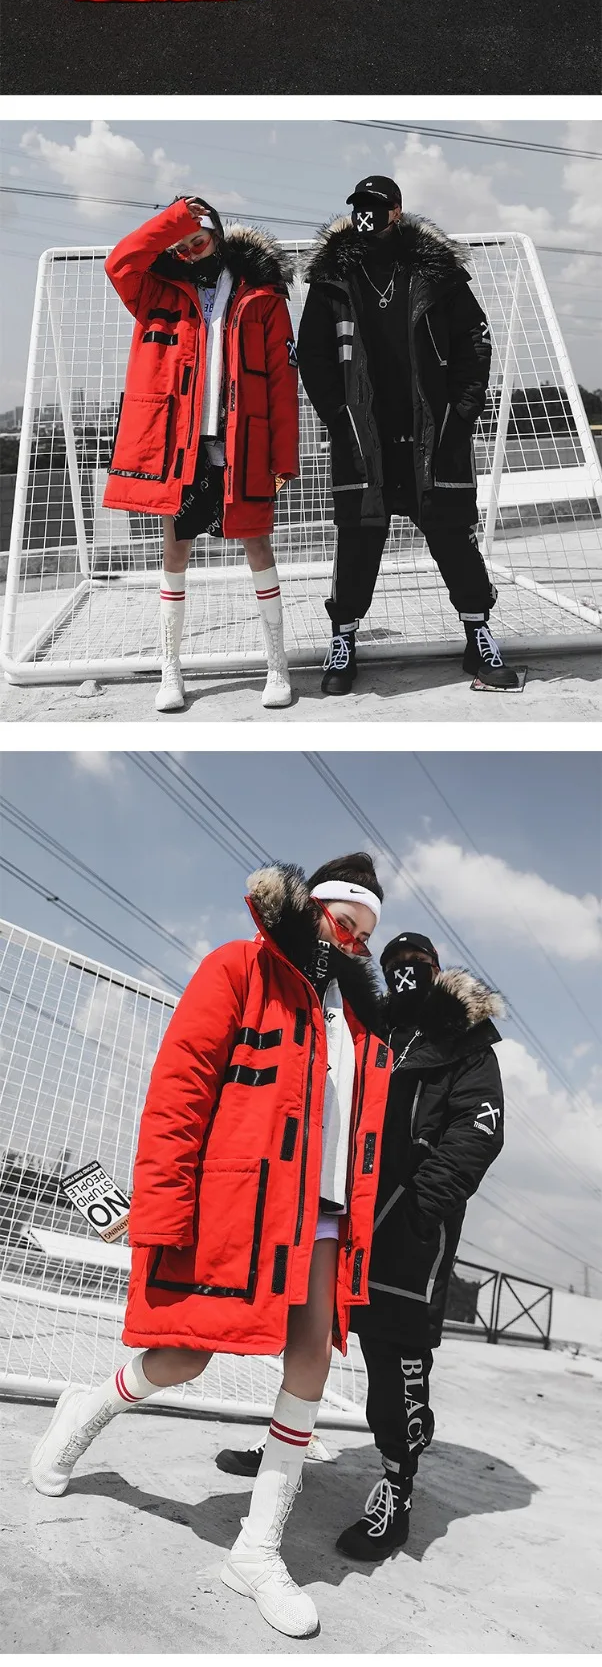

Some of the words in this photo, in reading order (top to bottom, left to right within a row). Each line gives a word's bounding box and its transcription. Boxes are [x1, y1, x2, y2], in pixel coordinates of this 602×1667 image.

[67, 1170, 106, 1198] PEOPLE
[76, 1180, 114, 1208] STUPID
[88, 1189, 131, 1227] NO
